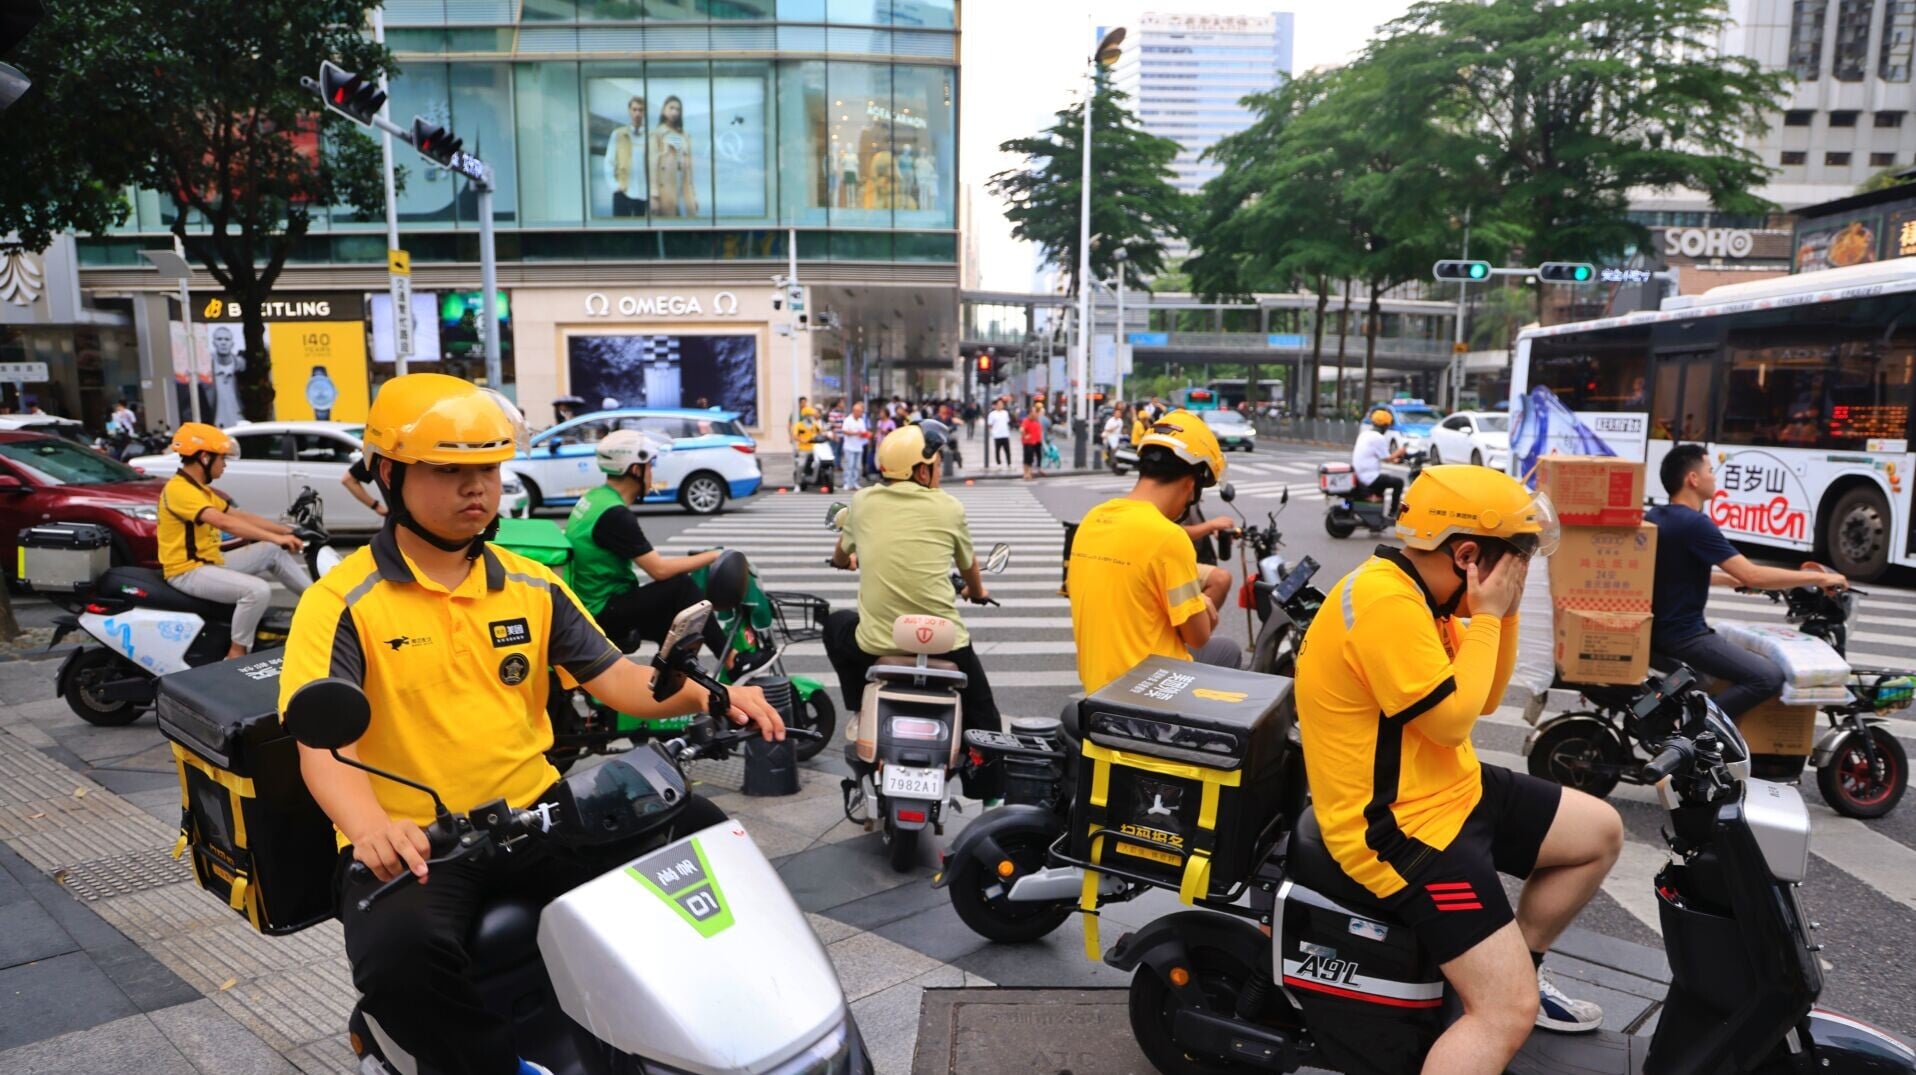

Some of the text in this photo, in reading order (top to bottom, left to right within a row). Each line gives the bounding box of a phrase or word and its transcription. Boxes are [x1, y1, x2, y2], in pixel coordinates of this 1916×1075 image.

[1664, 229, 1753, 258] SOHO
[228, 302, 330, 317] BITLING
[618, 296, 702, 316] OMEGA
[1724, 464, 1787, 494] 百岁山
[1120, 824, 1184, 848] 扫码报名
[687, 894, 717, 916] 01
[1294, 954, 1362, 988] A9L
